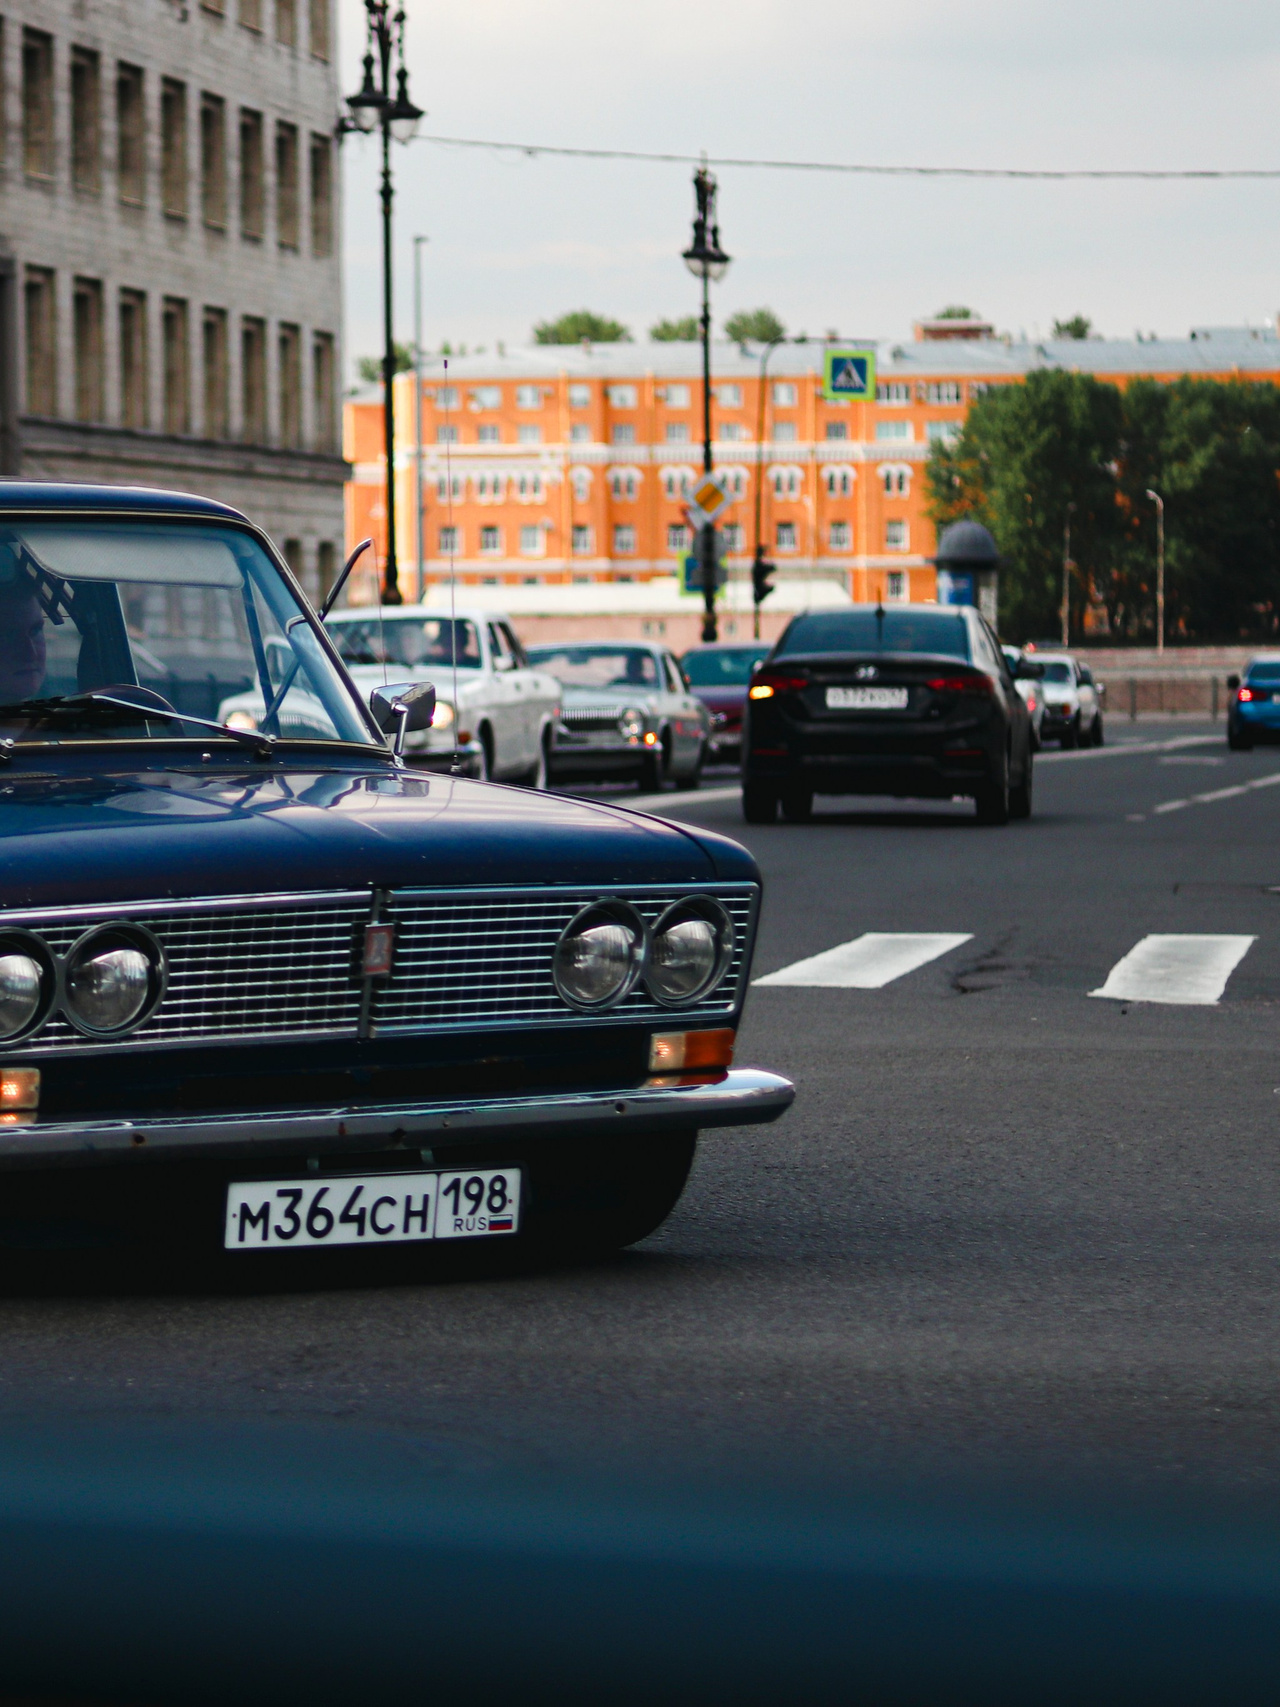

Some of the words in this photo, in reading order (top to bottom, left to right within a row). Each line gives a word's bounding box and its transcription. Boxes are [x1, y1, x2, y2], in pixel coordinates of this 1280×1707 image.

[238, 1185, 430, 1242] М364СН
[442, 1174, 508, 1216] 198
[453, 1217, 488, 1232] RUS
